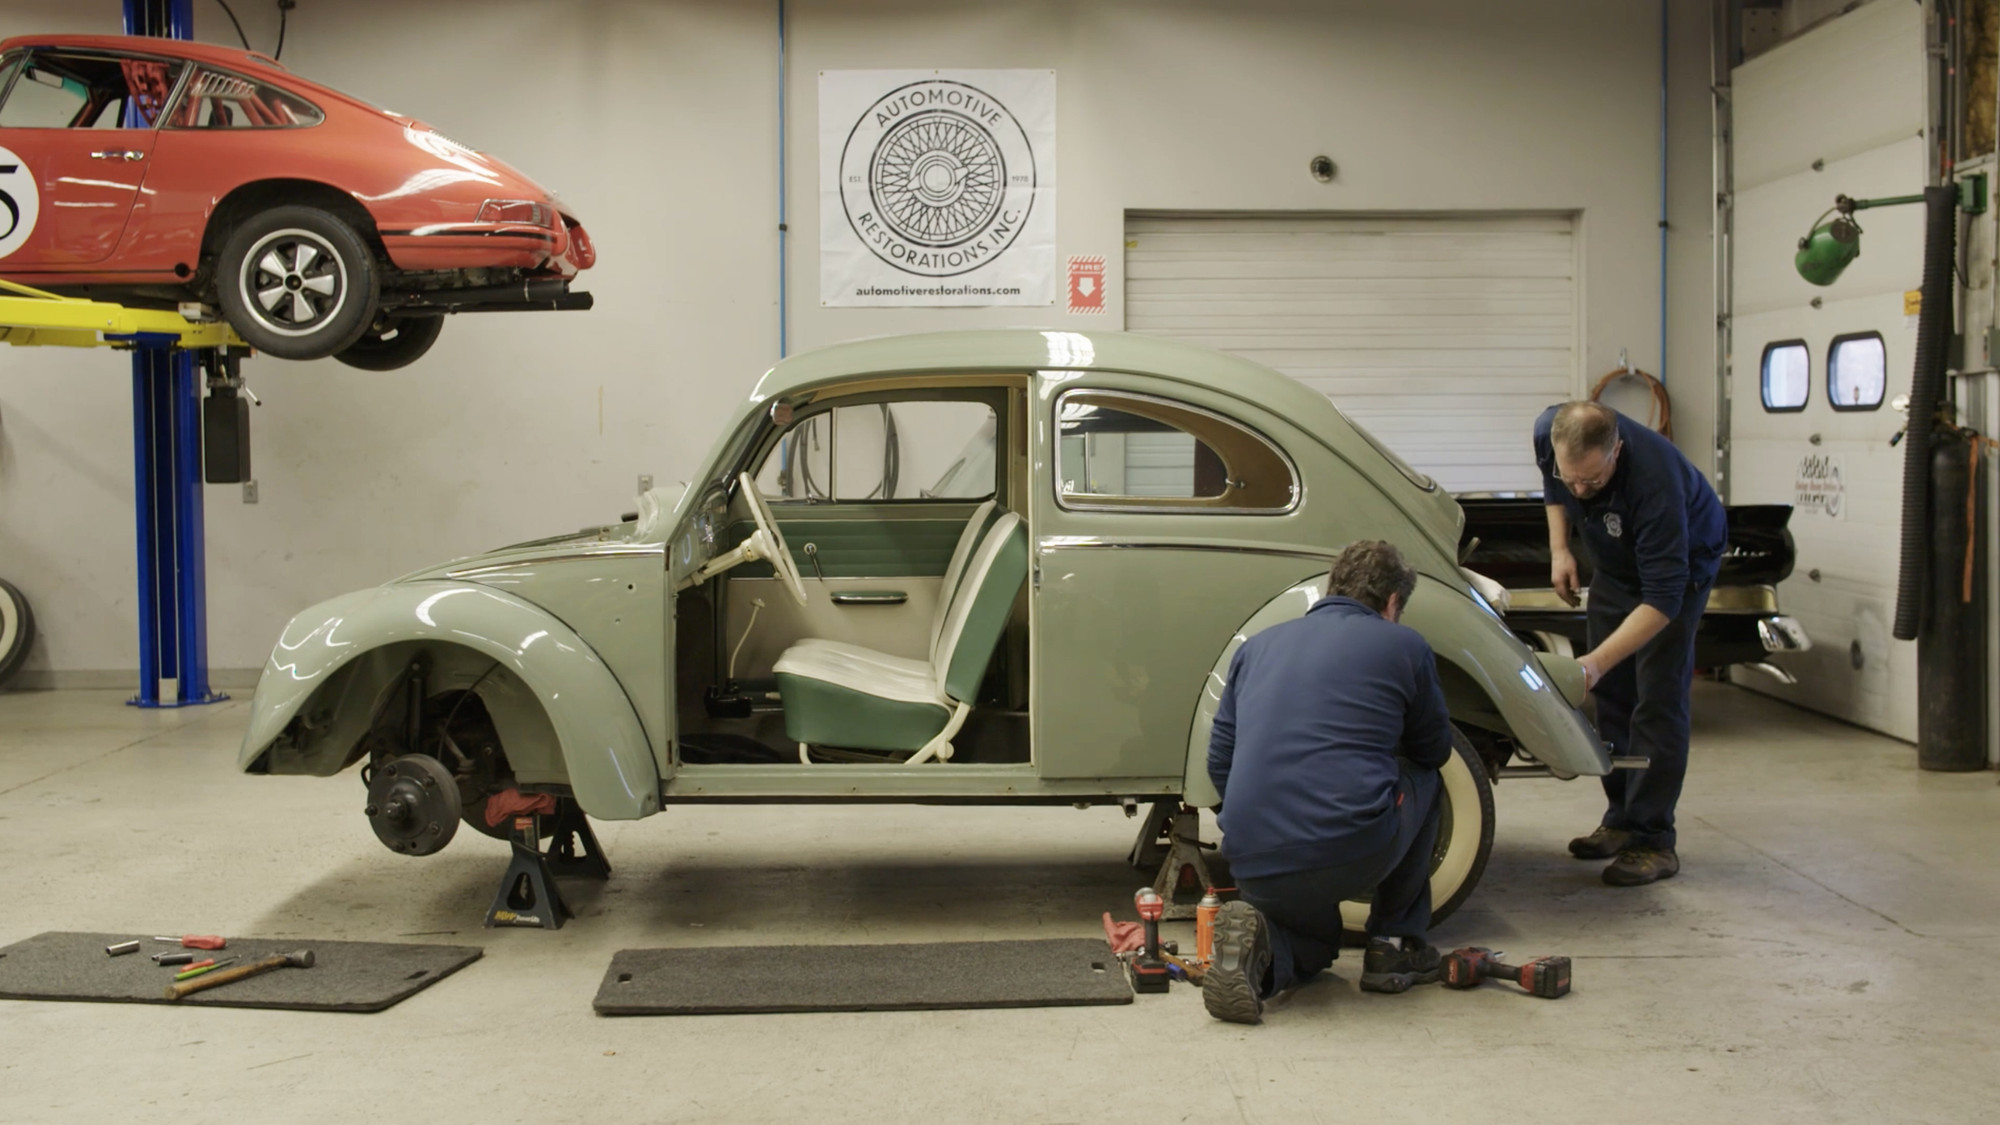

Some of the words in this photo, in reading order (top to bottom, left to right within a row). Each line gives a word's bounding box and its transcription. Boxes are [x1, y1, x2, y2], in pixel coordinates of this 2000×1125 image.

[875, 89, 1002, 128] AUTOMOTIVE
[857, 211, 989, 269] RESTORATIONS
[988, 209, 1022, 245] INC.
[855, 285, 1021, 296] automotiverestorations.com
